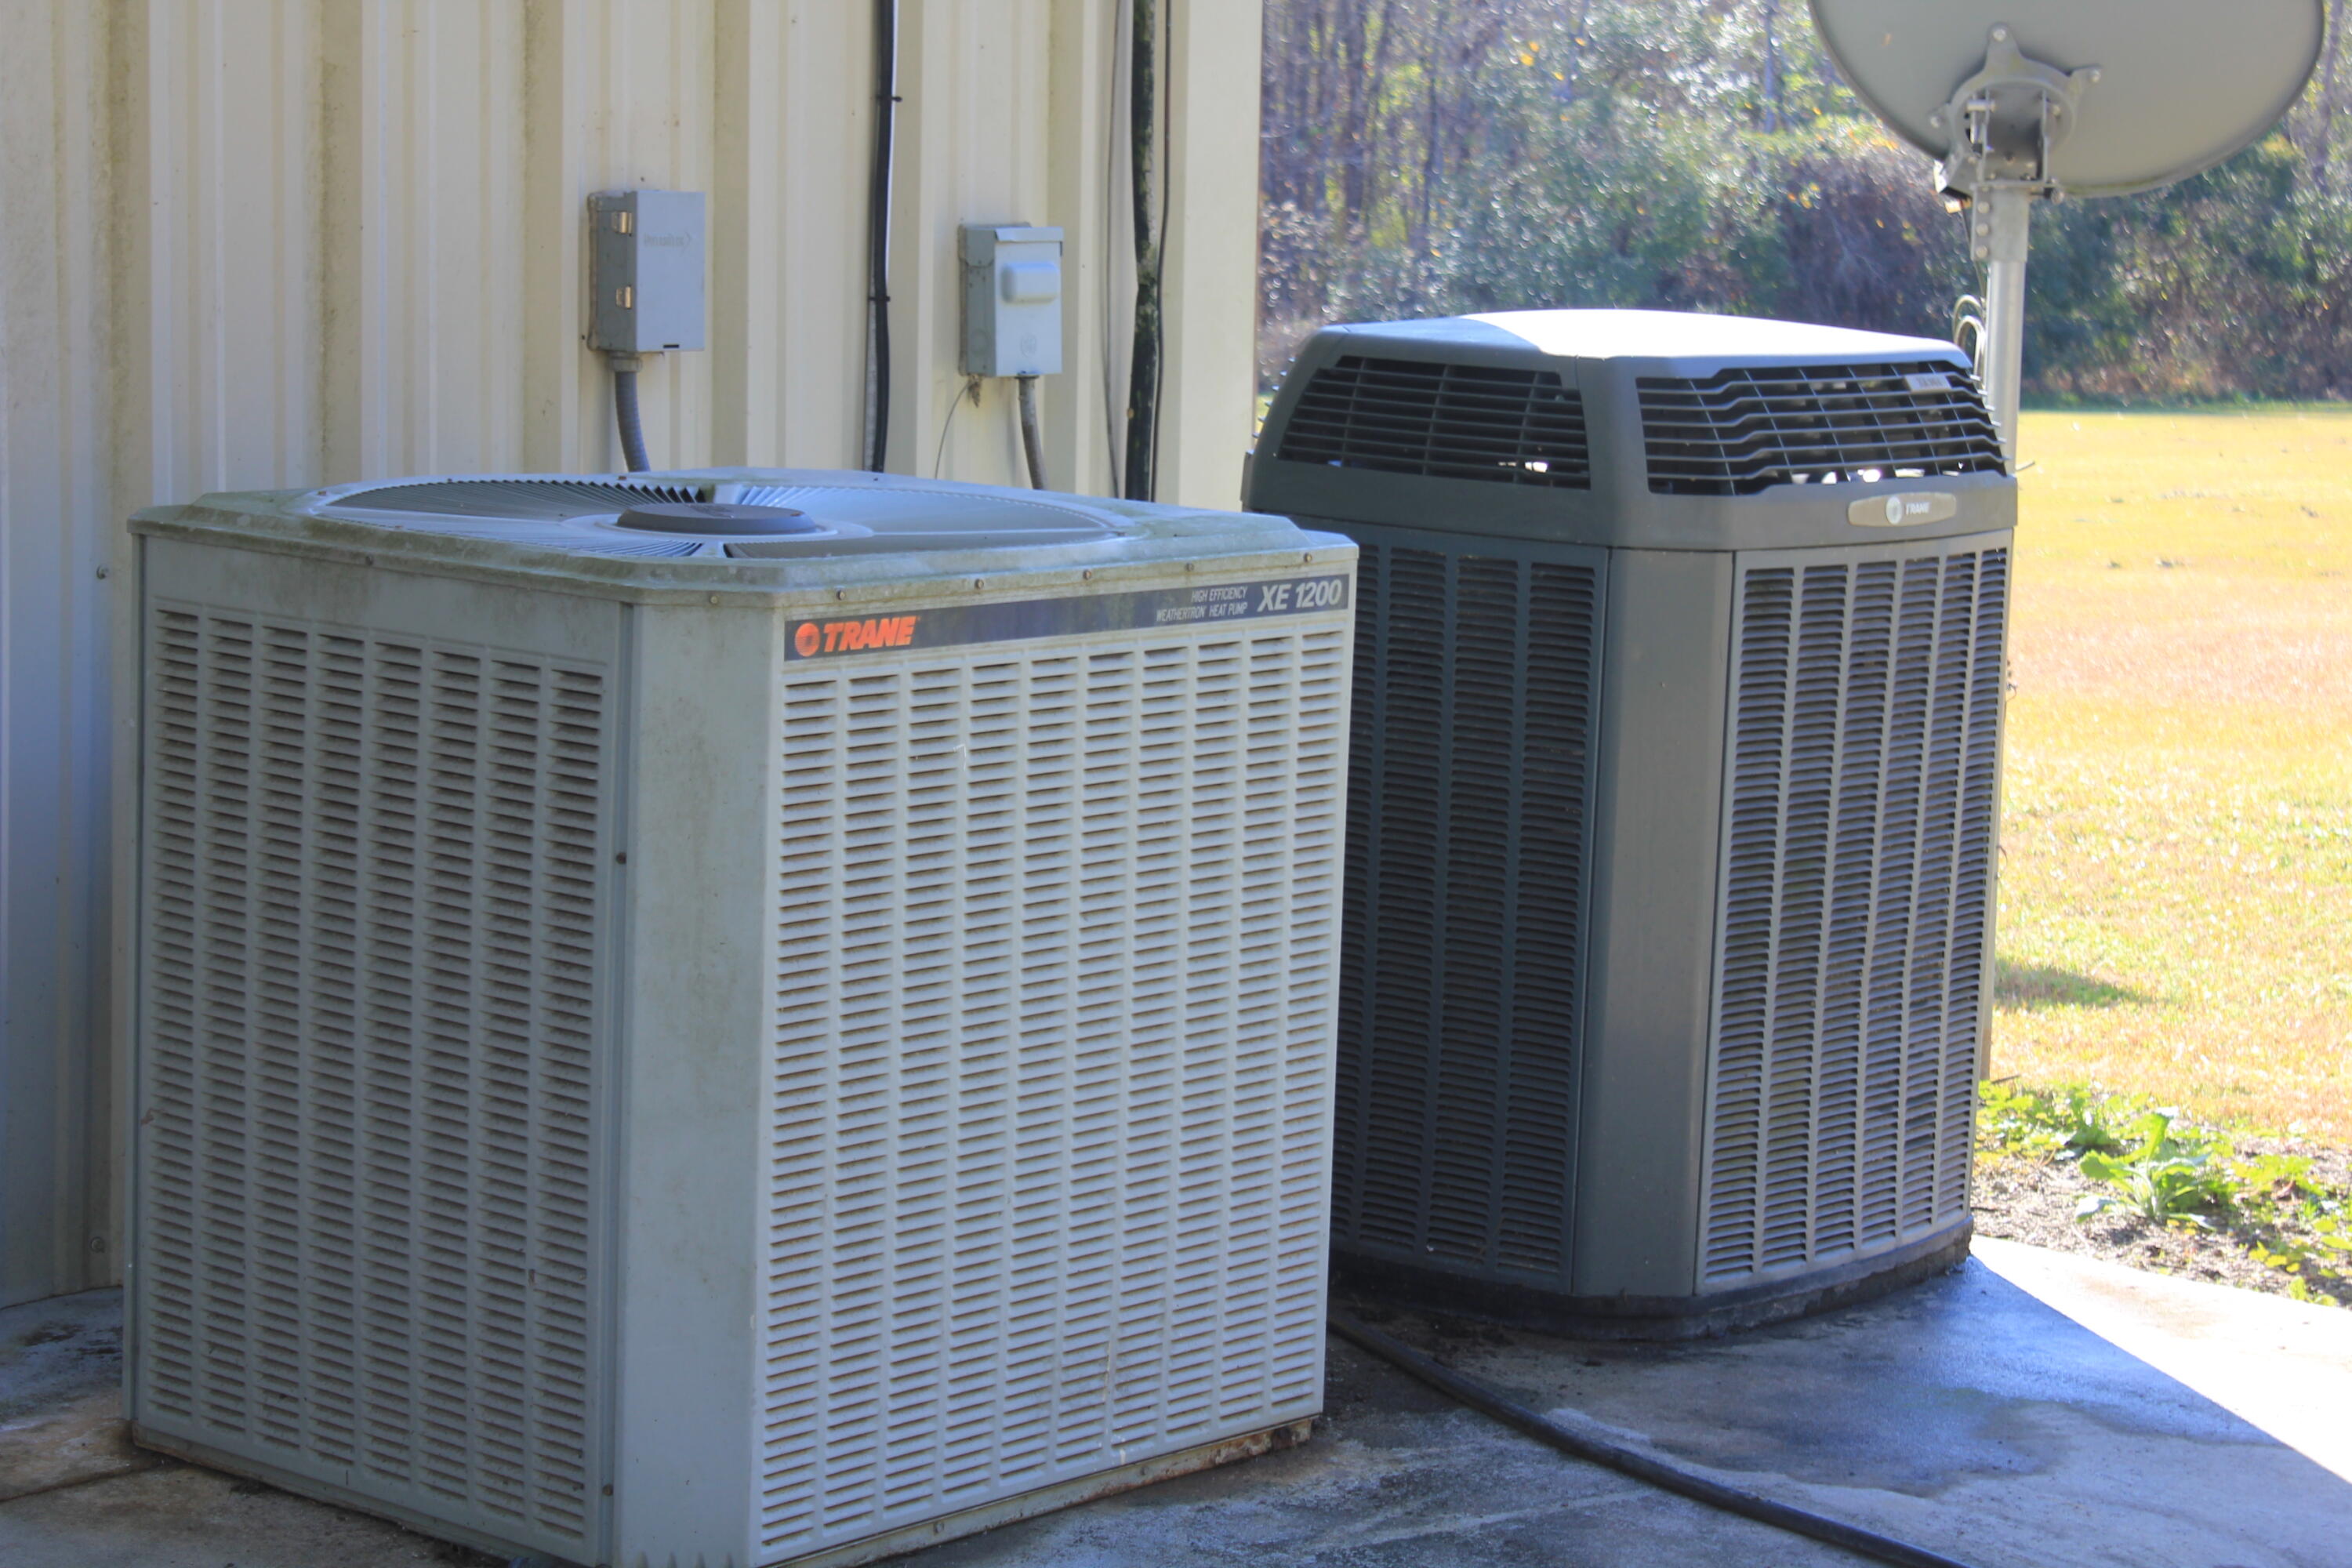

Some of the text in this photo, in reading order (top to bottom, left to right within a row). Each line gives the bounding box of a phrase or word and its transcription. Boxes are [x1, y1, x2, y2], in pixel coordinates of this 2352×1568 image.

[1192, 586, 1248, 603] HIGH EFFICIENCY
[1257, 579, 1342, 612] XE 1200
[1156, 601, 1248, 622] WEATHERTRON HEAT PUMP
[823, 615, 917, 652] TRANE
